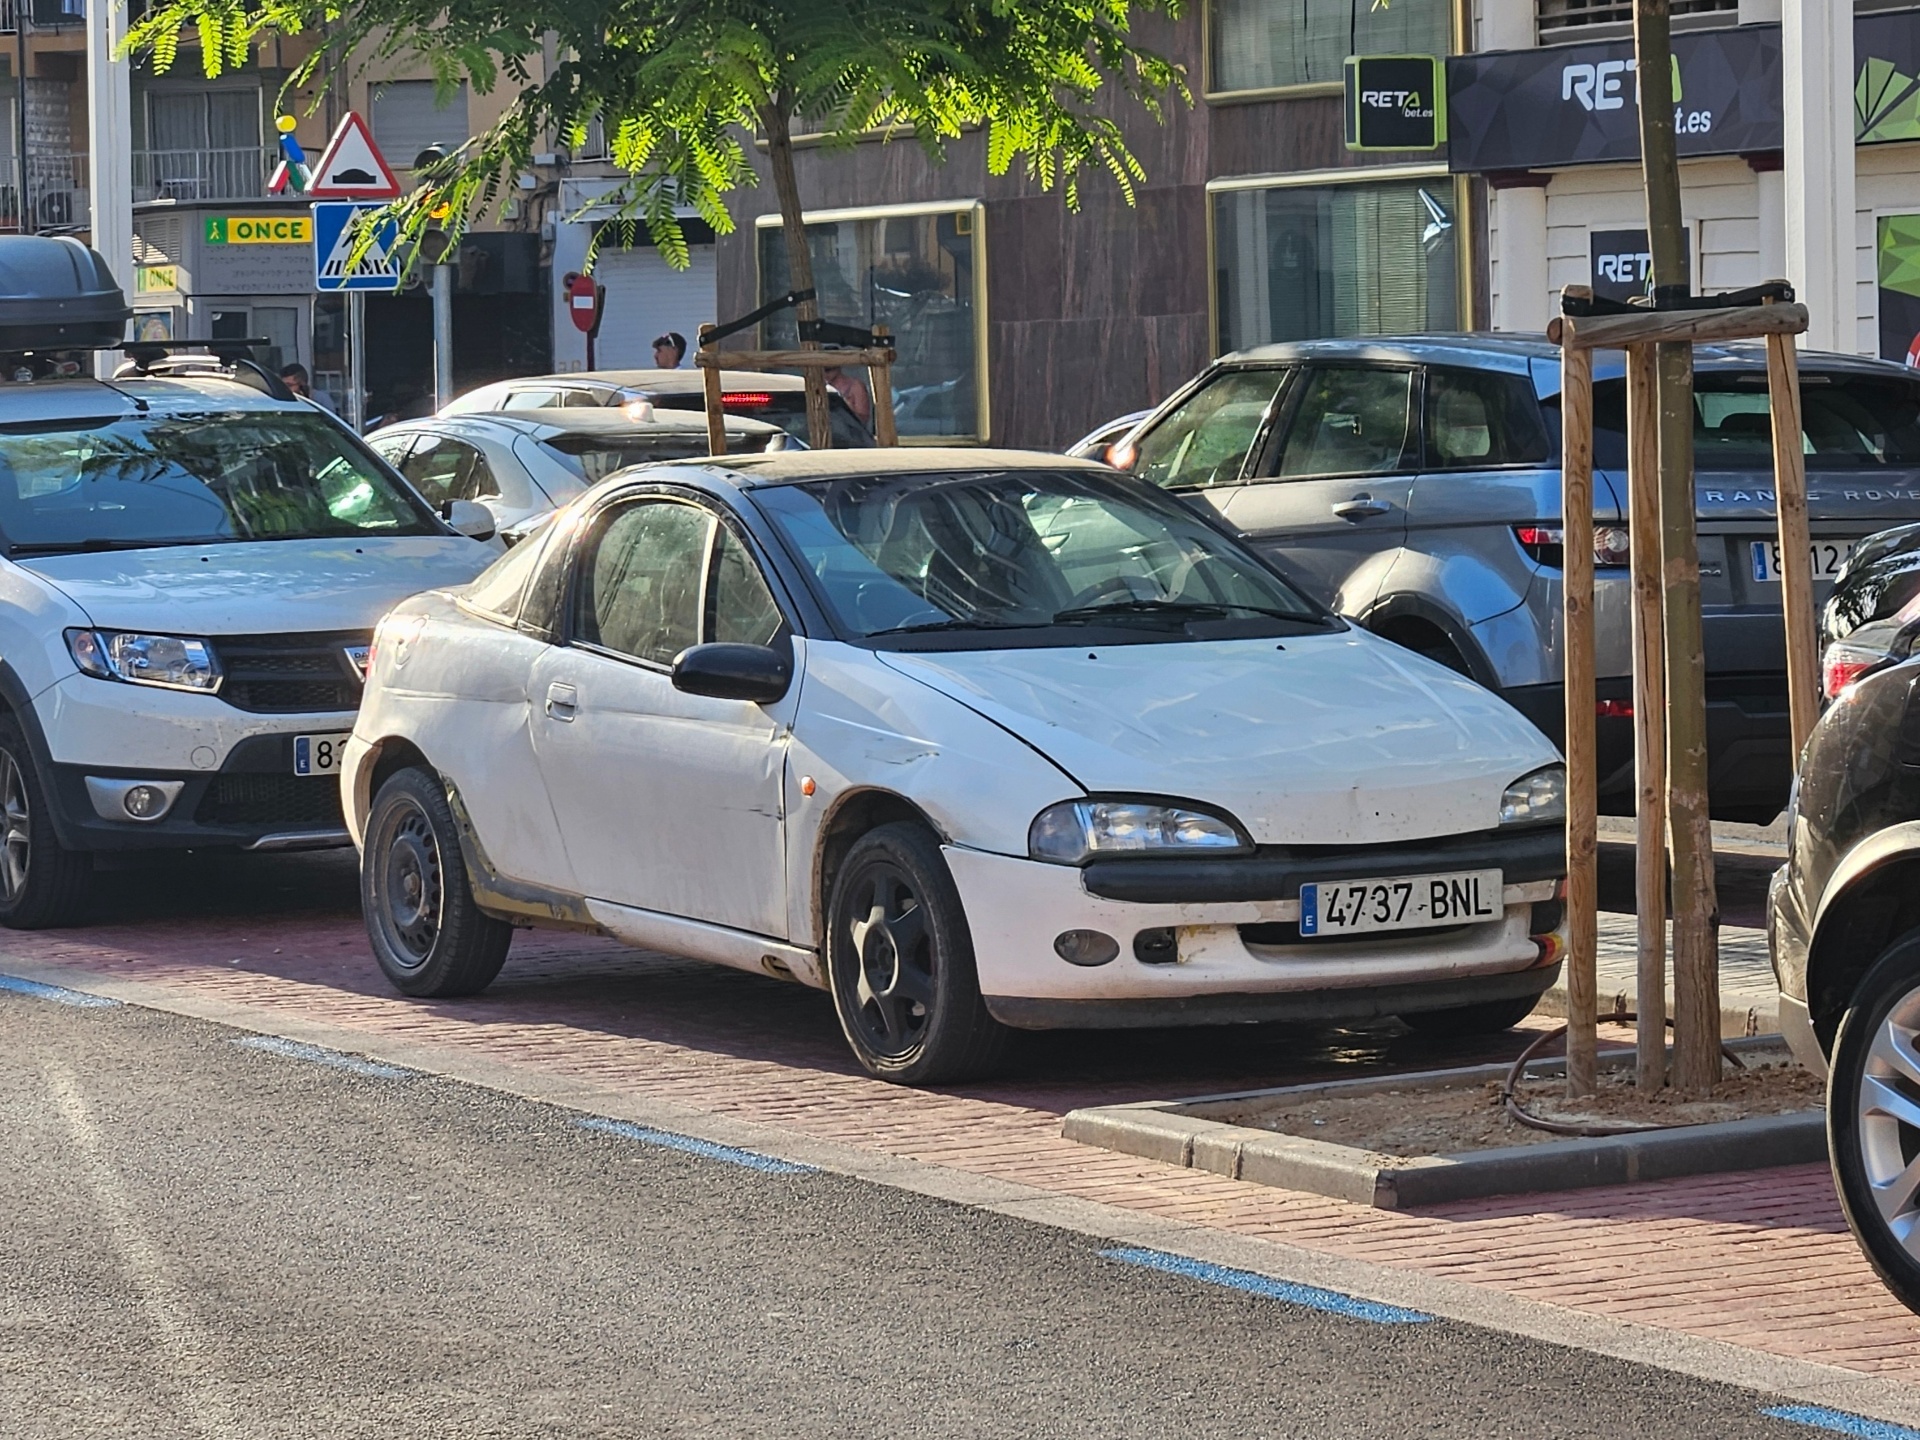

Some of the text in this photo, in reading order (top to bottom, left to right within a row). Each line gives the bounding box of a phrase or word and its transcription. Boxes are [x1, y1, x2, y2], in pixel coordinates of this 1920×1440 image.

[1562, 53, 1683, 111] RE
[1362, 91, 1420, 114] RETA
[1404, 108, 1434, 118] bet.es
[1674, 106, 1712, 134] t.es
[237, 222, 303, 239] ONCE
[150, 269, 174, 287] ONCE
[1598, 252, 1653, 294] RET
[1705, 490, 1820, 501] RANE
[1772, 545, 1839, 575] 812
[300, 759, 307, 768] E
[1305, 877, 1493, 927] E 4737 BNL
